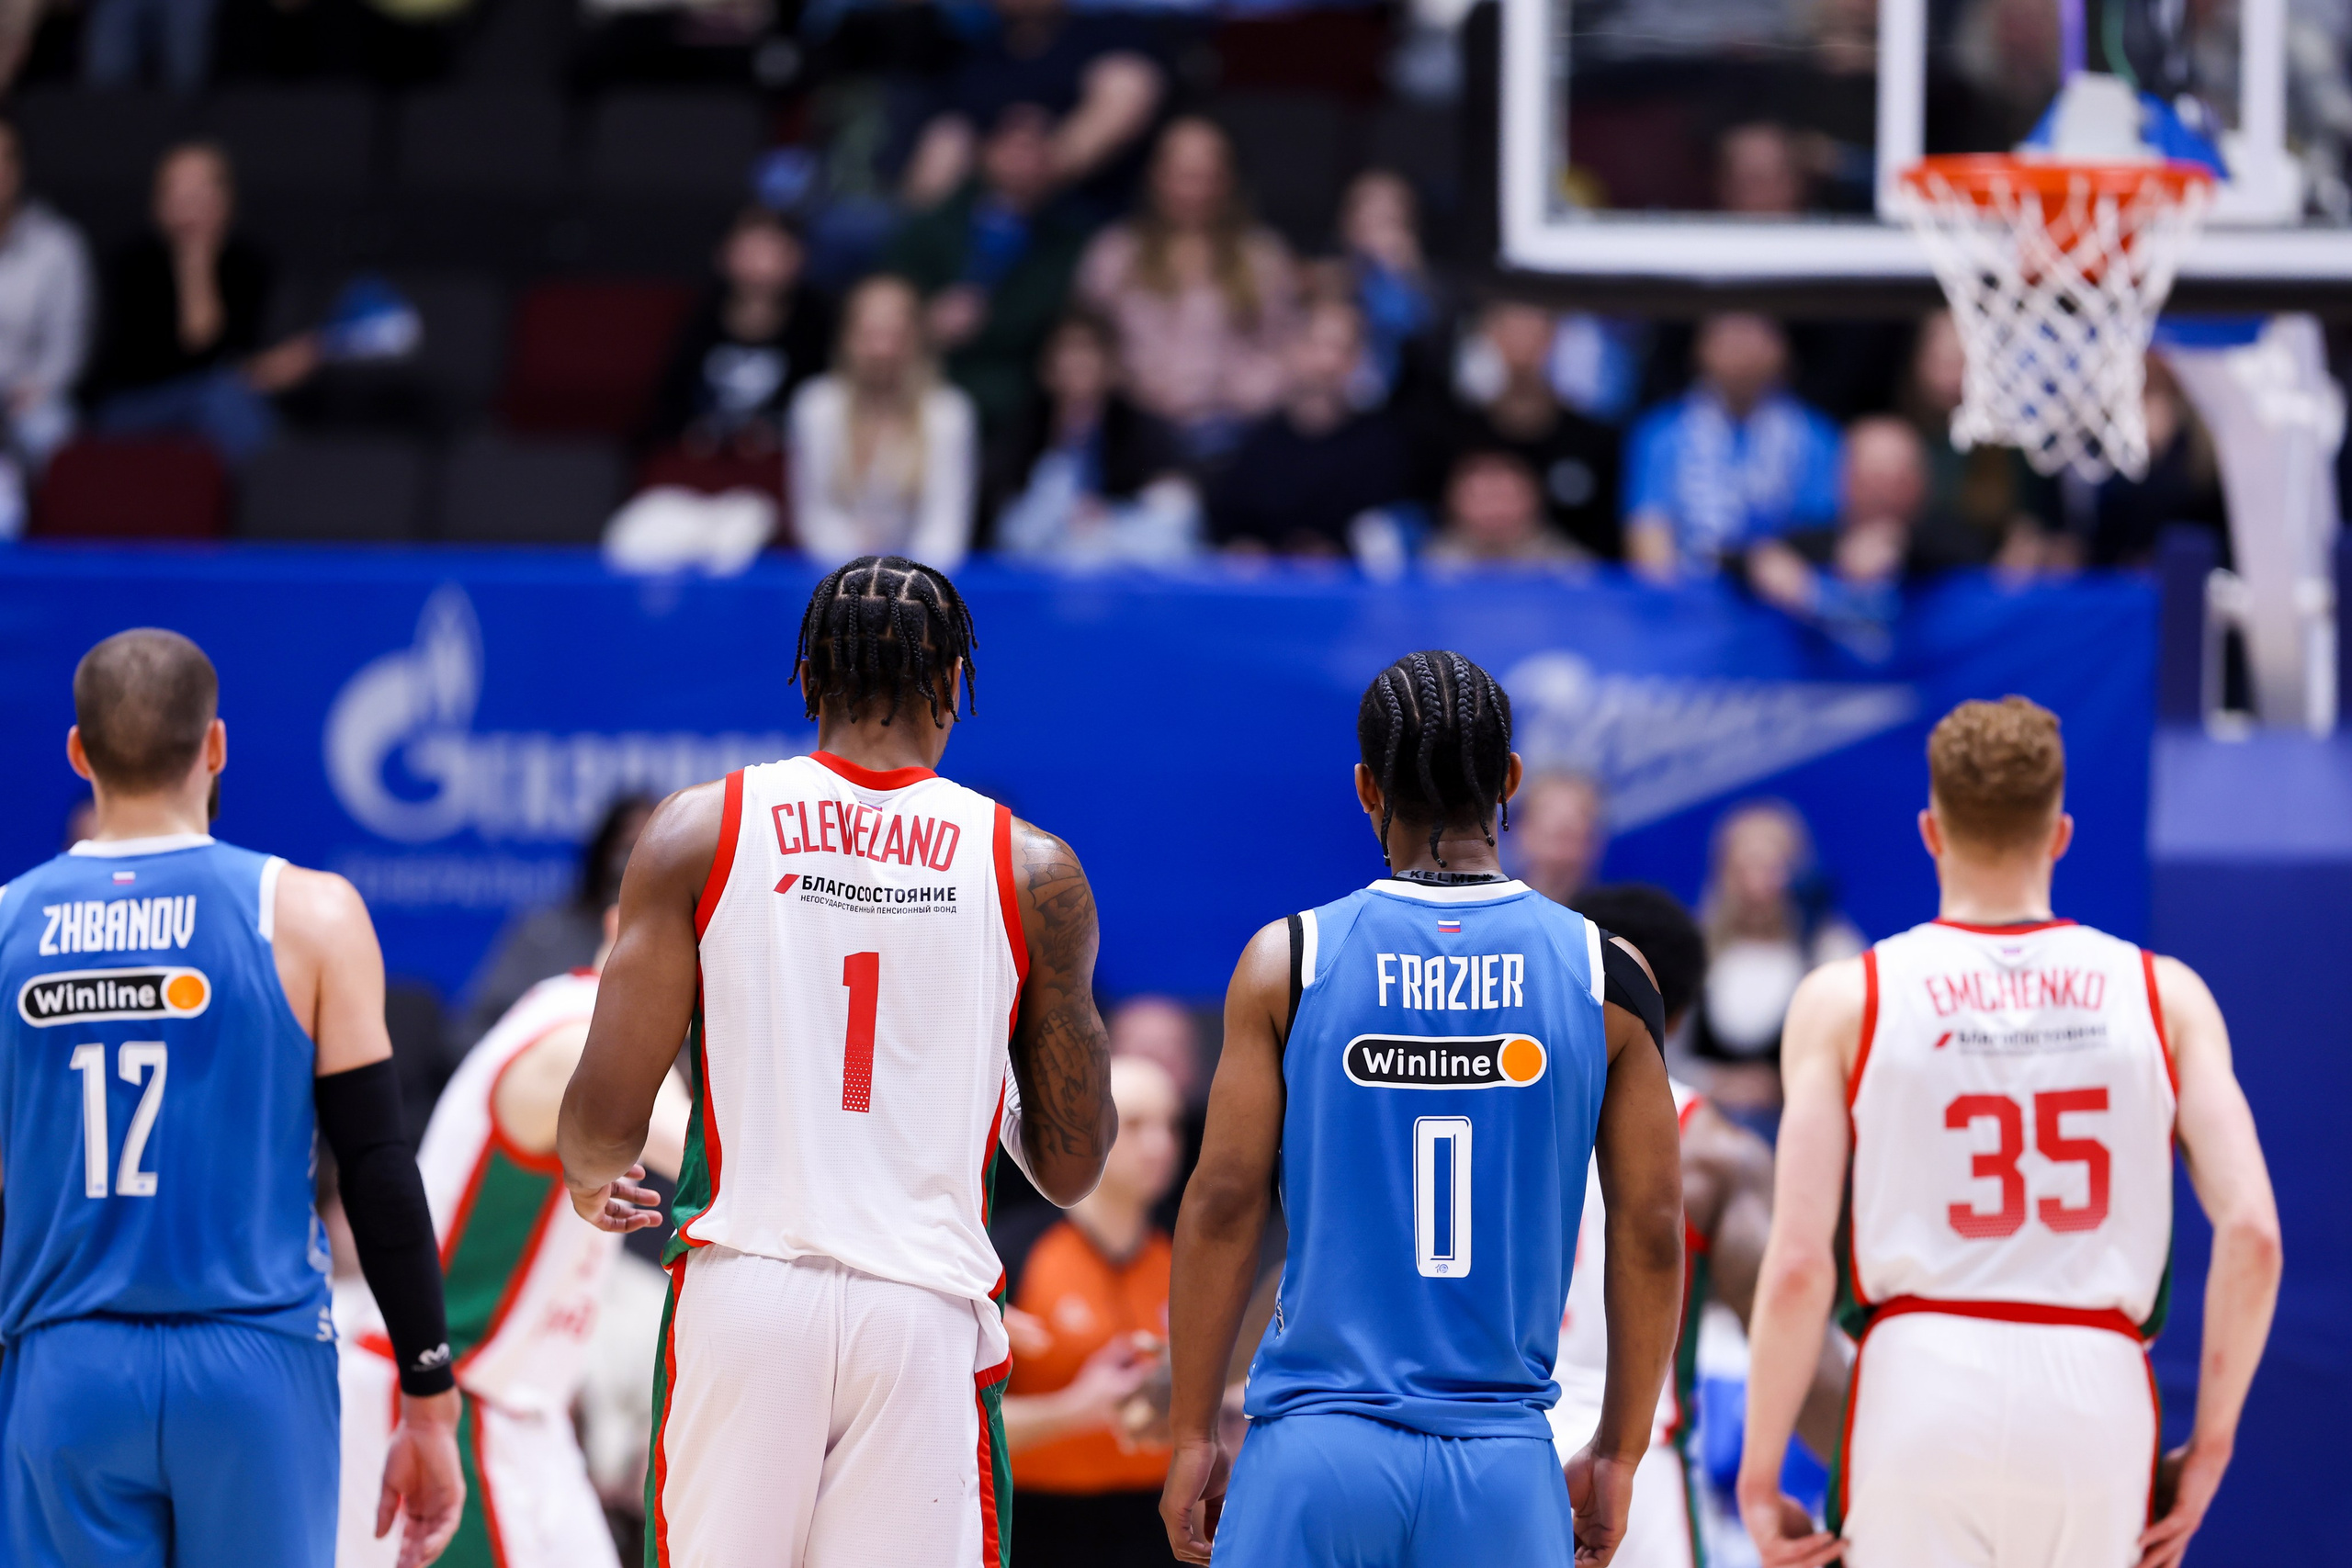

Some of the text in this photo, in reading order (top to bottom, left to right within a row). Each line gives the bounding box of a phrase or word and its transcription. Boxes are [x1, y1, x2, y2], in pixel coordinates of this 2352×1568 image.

[772, 800, 960, 872] CLEVELAND
[800, 895, 956, 915] НЕГОСУДАРСТВЕННЫЙ ПЕНСИОННЫЙ ФОНД
[802, 875, 956, 904] БЛАГОСОСТОЯНИЕ
[1409, 870, 1478, 883] KELME
[39, 895, 197, 956] ZHBANOV
[33, 980, 156, 1013] Winline
[1377, 953, 1524, 1010] FRAZIER
[1925, 967, 2106, 1017] EMCHENKO
[842, 952, 879, 1113] 1
[1363, 1047, 1491, 1077] Winline
[69, 1041, 167, 1198] 12
[1944, 1087, 2110, 1239] 35
[1413, 1115, 1472, 1278] 0
